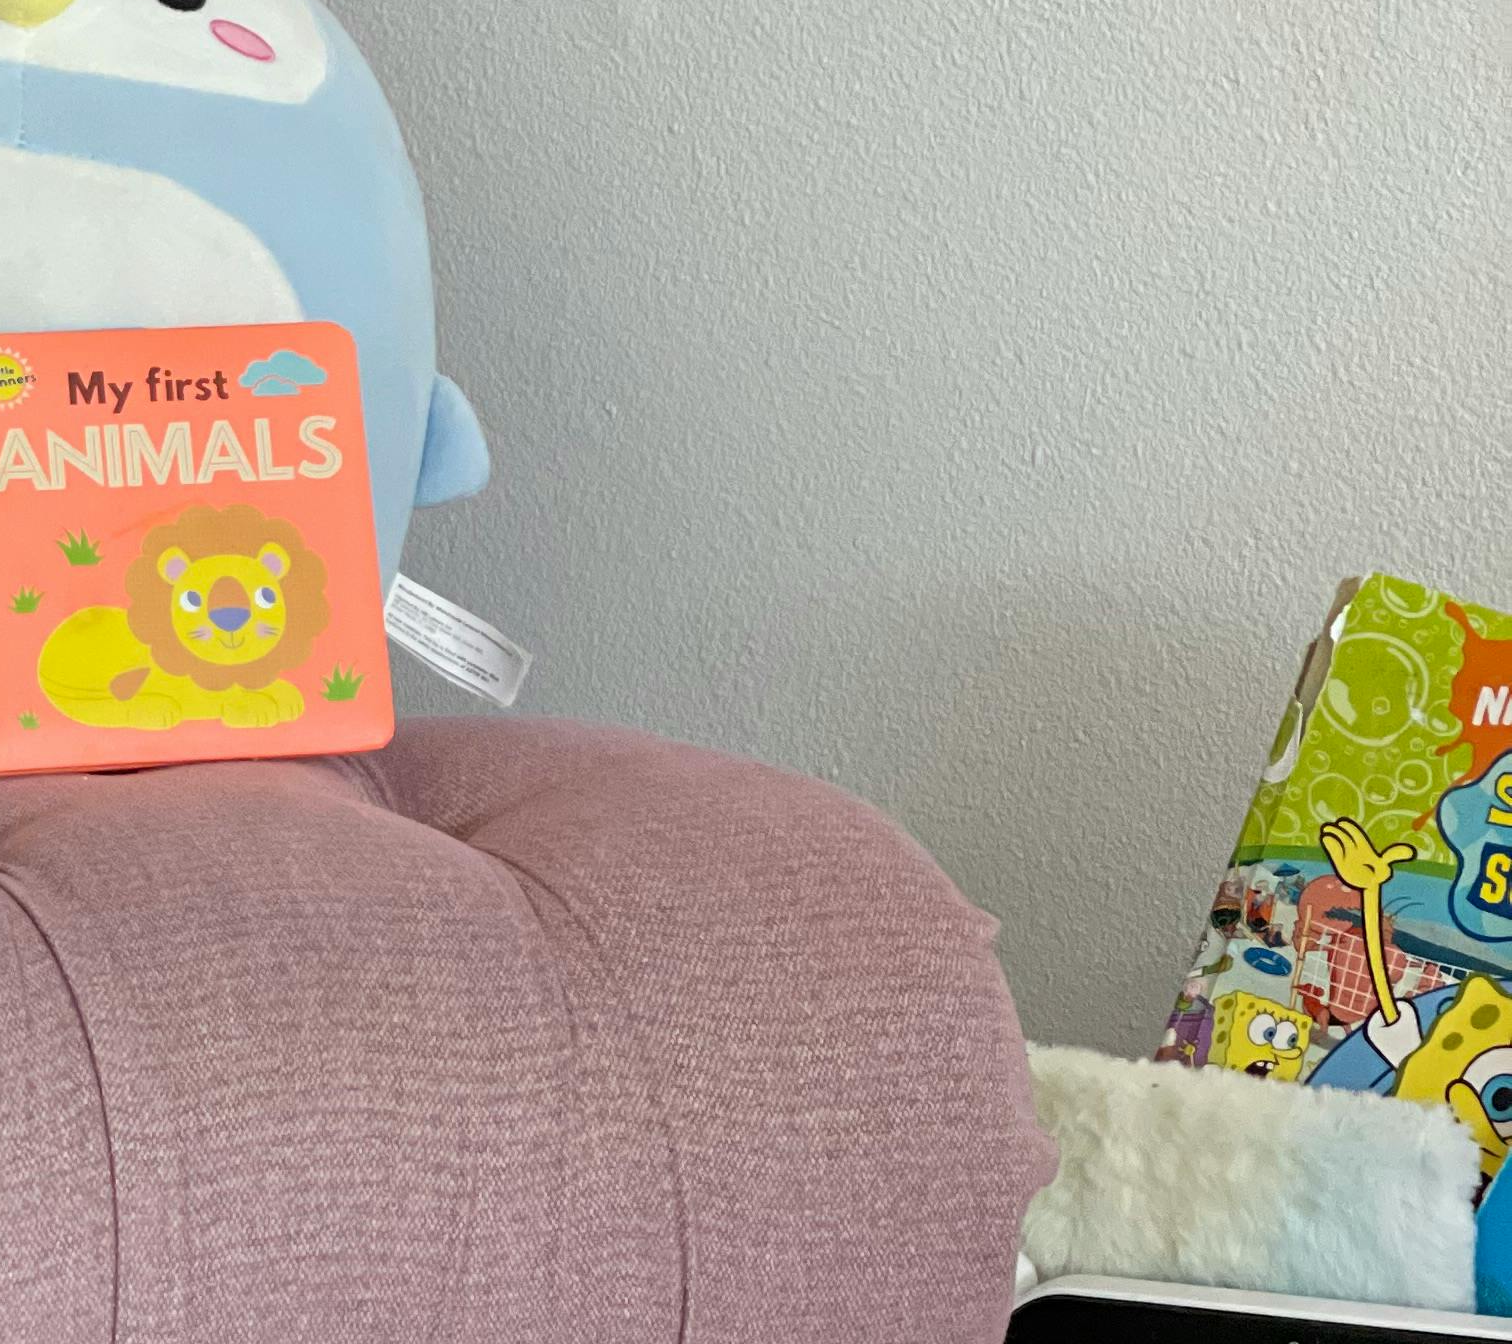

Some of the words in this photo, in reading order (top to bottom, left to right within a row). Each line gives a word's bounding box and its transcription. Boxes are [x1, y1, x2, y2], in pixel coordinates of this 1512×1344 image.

[67, 370, 133, 414] My
[145, 366, 230, 402] first
[1480, 852, 1512, 904] S
